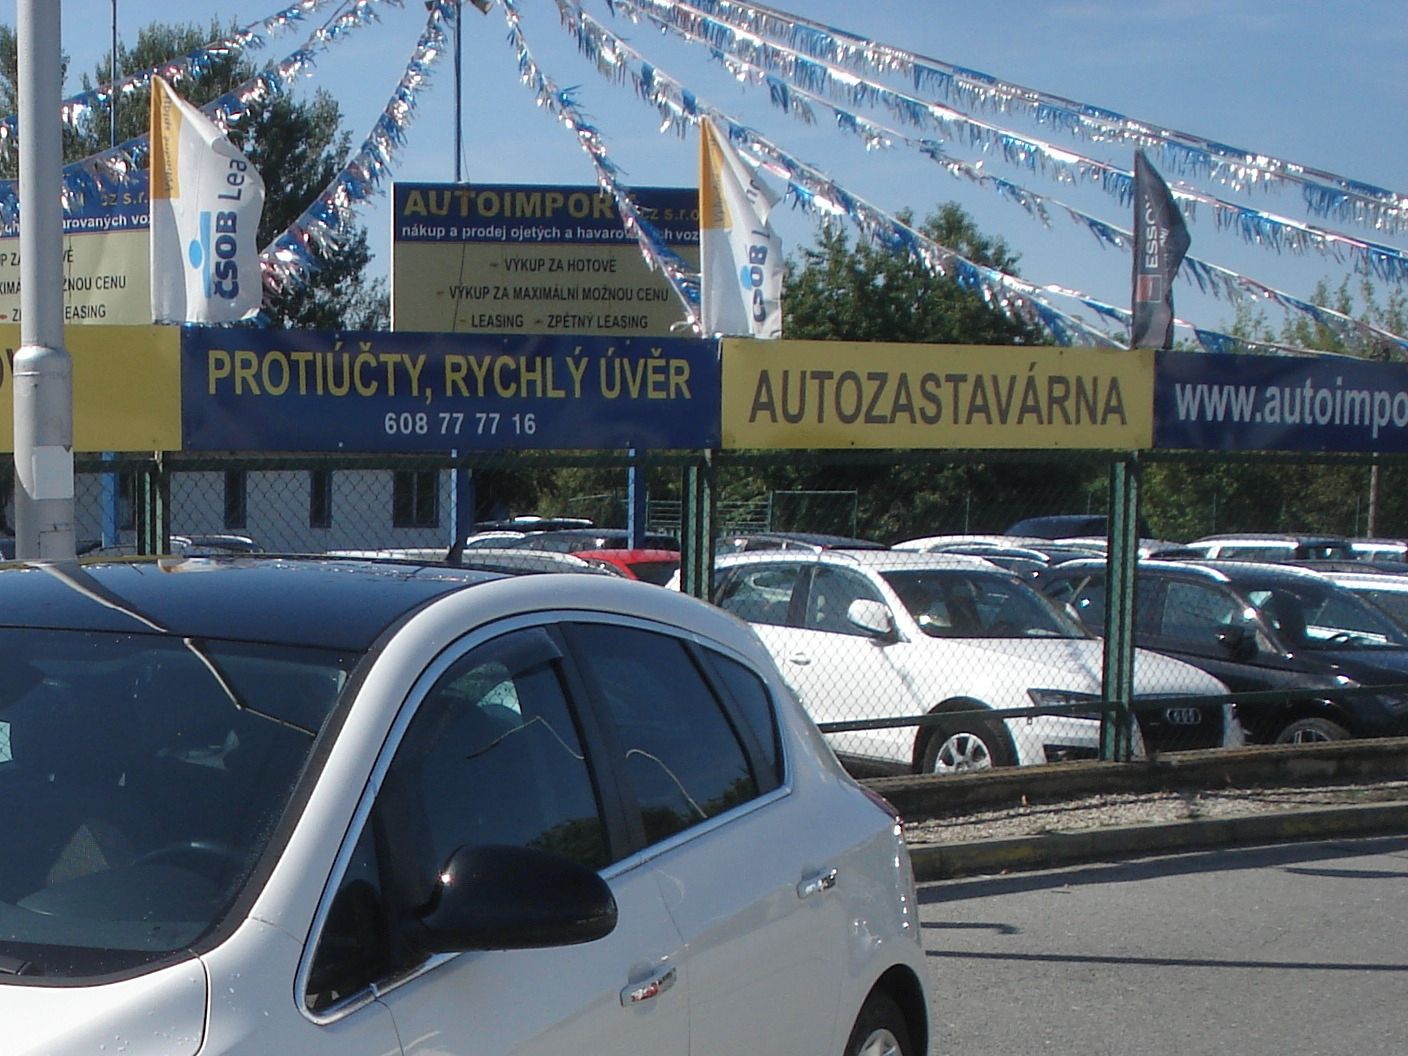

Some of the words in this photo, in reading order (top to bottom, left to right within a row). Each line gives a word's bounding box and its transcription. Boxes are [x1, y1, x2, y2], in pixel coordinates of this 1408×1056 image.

[403, 189, 616, 219] AUTOIMPOR
[402, 224, 445, 238] nákup
[450, 226, 458, 237] a
[462, 225, 506, 240] prodej
[511, 225, 561, 241] ojetých
[565, 228, 573, 239] a
[676, 231, 699, 241] voz
[214, 211, 240, 300] ČSOB
[505, 256, 545, 272] VÝKUP
[548, 258, 564, 272] ZA
[95, 275, 127, 290] CENU
[449, 283, 490, 300] VÝKUP
[494, 286, 510, 300] ZA
[513, 284, 579, 301] MAXIMÁLNÍ
[637, 287, 669, 302] CENU
[65, 304, 106, 319] EASING
[471, 314, 524, 329] LEASING
[597, 314, 648, 329] LEASING
[208, 341, 433, 405] PROTIÚČTY,
[445, 346, 589, 399] RYCHLÝ
[600, 347, 692, 400] ÚVĚR
[748, 362, 1128, 427] AUTOZASTAVÁRNA
[1175, 376, 1408, 439] www.autoimpo
[384, 412, 428, 436] 608
[438, 412, 464, 435] 77
[476, 412, 501, 435] 77
[512, 412, 536, 435] 16
